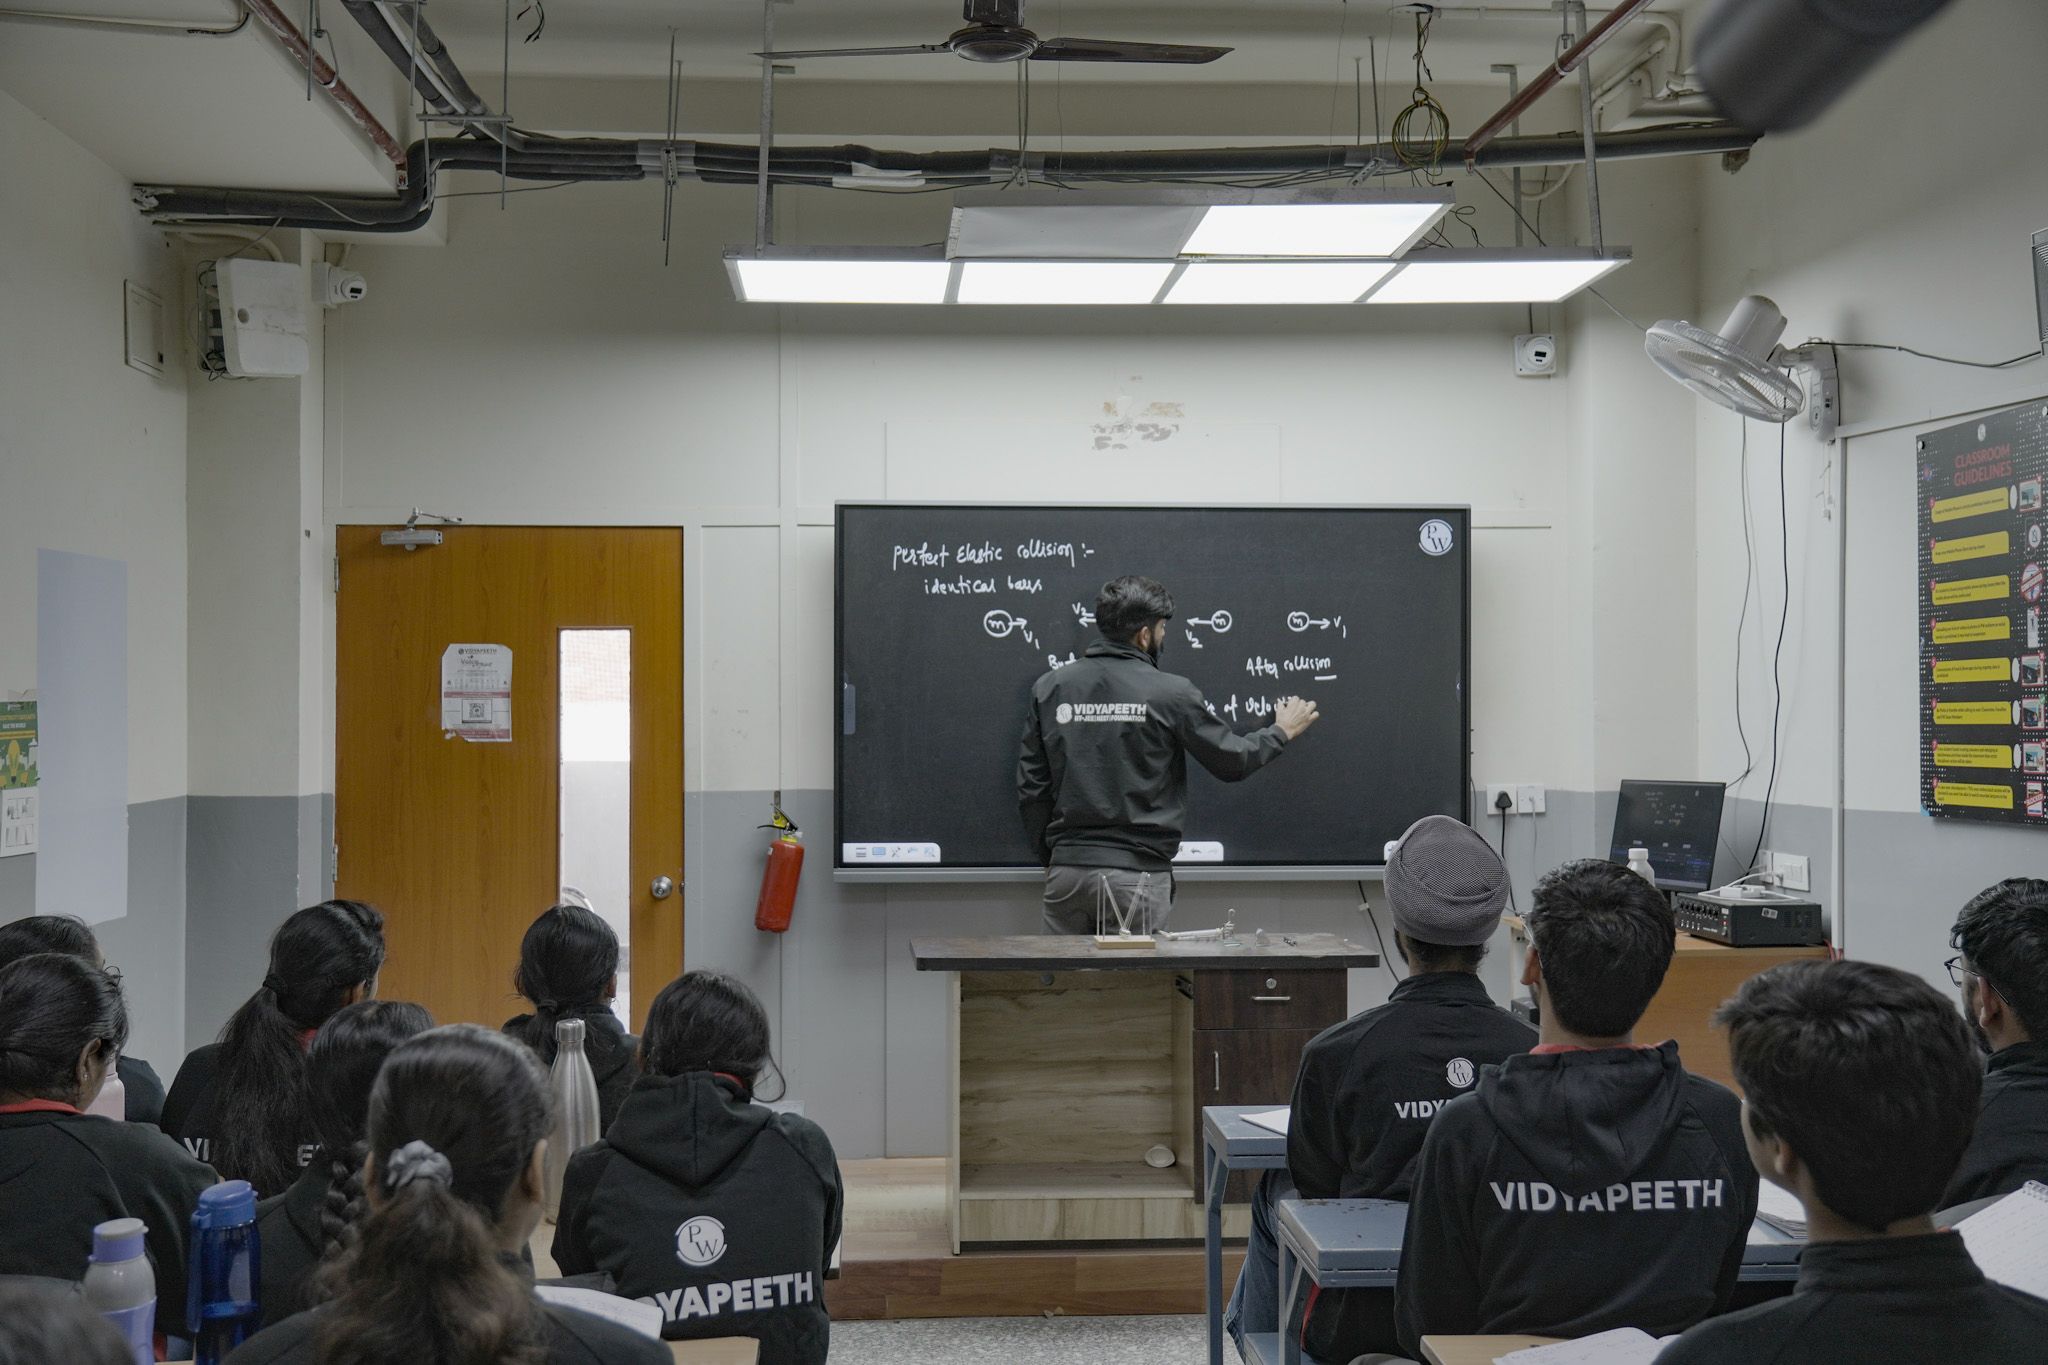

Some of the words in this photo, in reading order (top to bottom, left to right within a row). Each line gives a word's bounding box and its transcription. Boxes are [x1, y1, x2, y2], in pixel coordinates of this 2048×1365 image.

[1954, 443, 2011, 469] CLASSROOM
[1954, 461, 2012, 487] GUIDELINES
[924, 575, 996, 595] identical
[1073, 703, 1147, 715] VIDYAPEETH
[1489, 1179, 1723, 1212] VIDYAPEETH
[634, 1271, 814, 1322] YAPEETH
